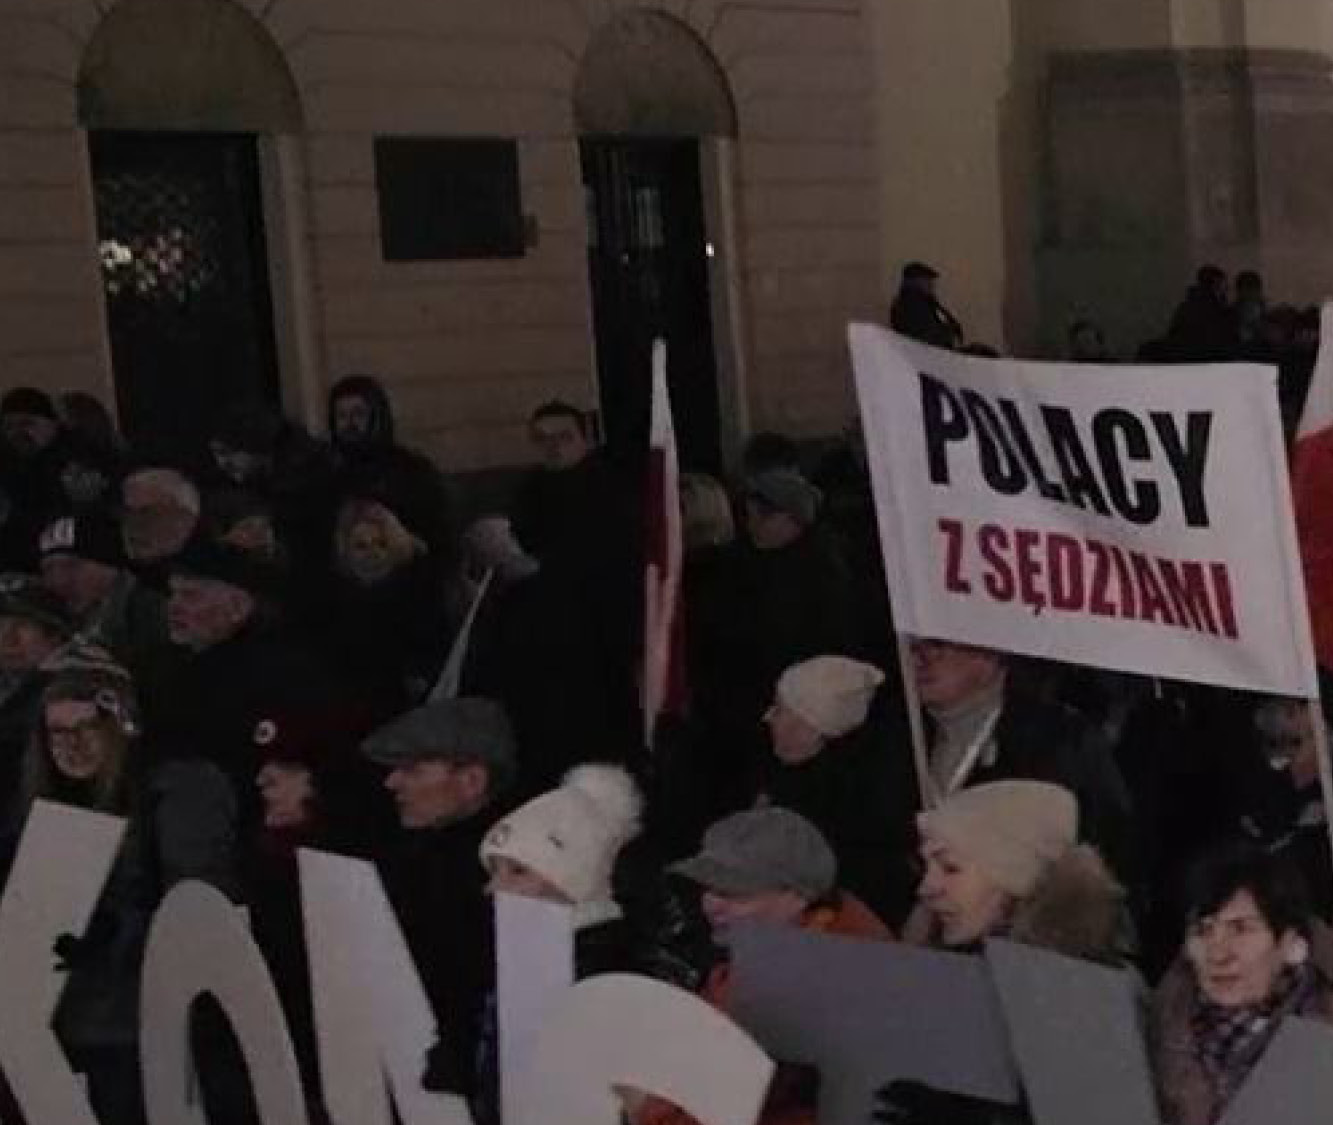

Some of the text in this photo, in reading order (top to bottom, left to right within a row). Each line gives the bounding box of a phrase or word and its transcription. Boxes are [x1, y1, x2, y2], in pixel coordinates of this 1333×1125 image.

[917, 371, 1213, 528] POLACY
[938, 518, 1239, 640] Z SĘDZIAMI
